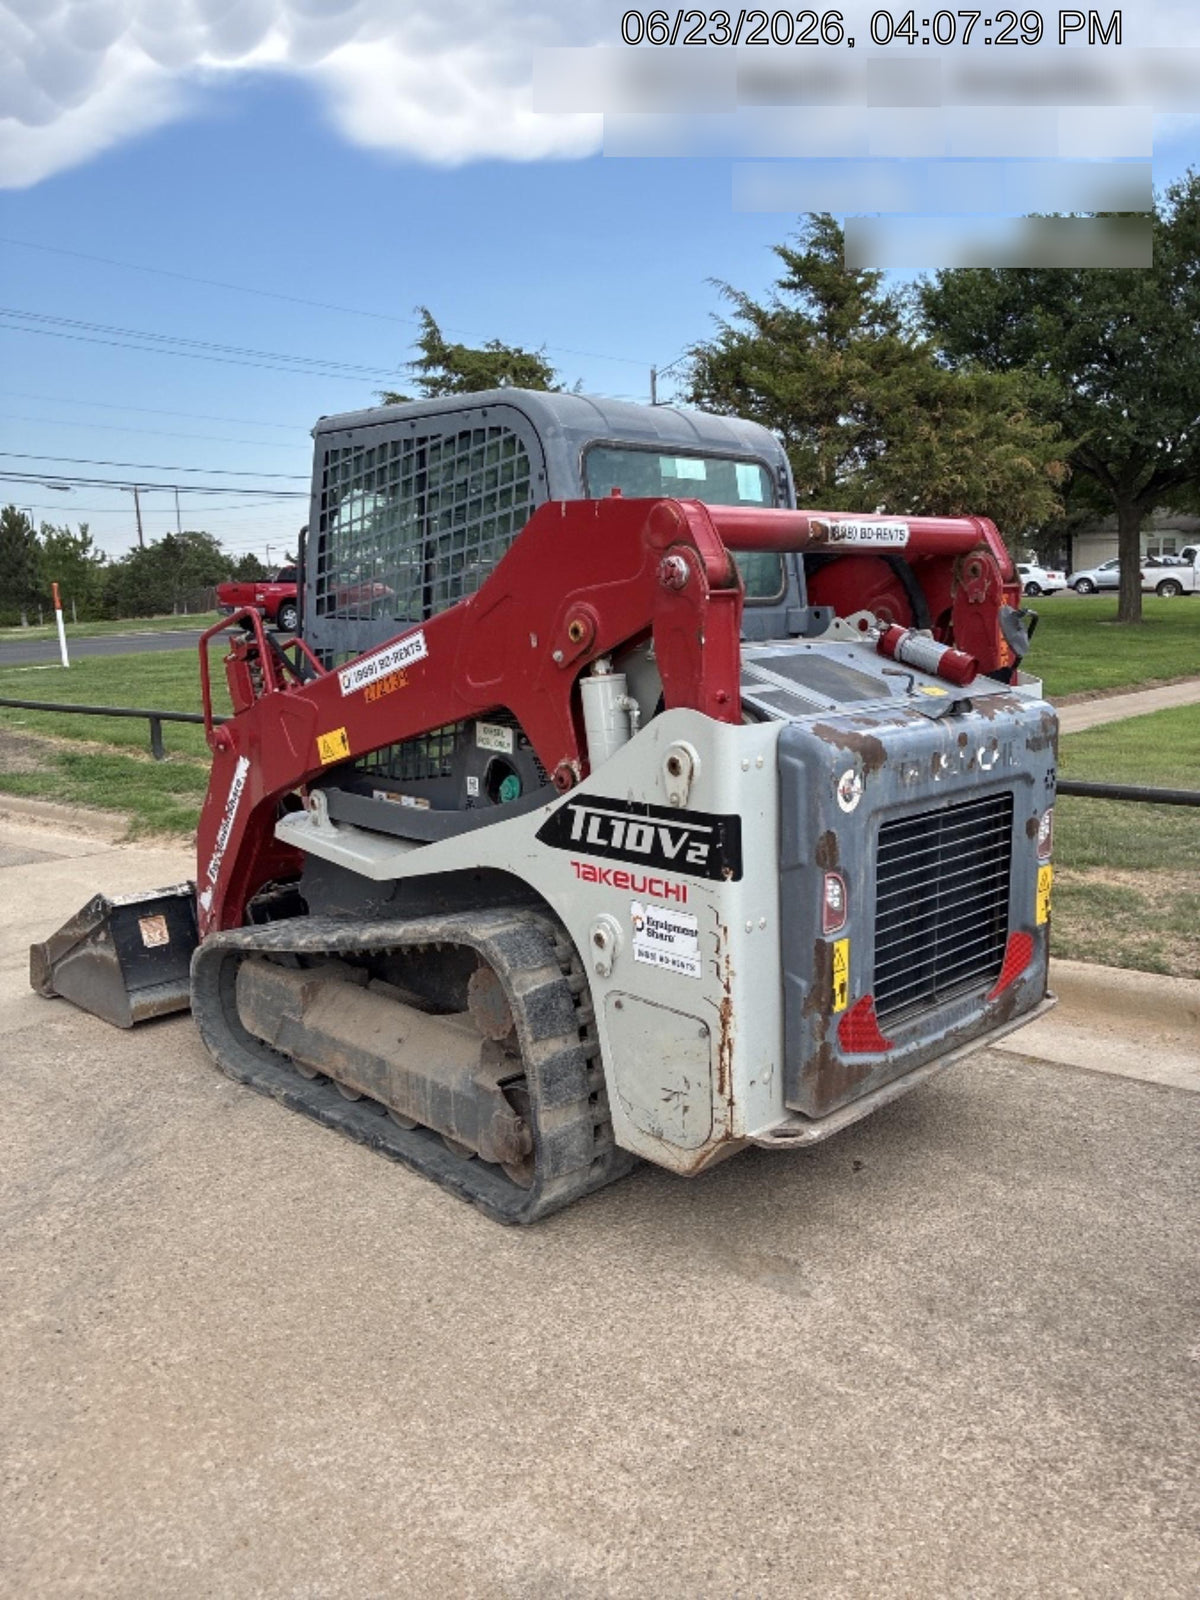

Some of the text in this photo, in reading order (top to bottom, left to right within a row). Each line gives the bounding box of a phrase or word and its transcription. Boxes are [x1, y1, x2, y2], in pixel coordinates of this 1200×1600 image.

[567, 803, 713, 865] TL10V2
[570, 861, 688, 904] TAKEUCHI
[646, 915, 699, 938] Equipment
